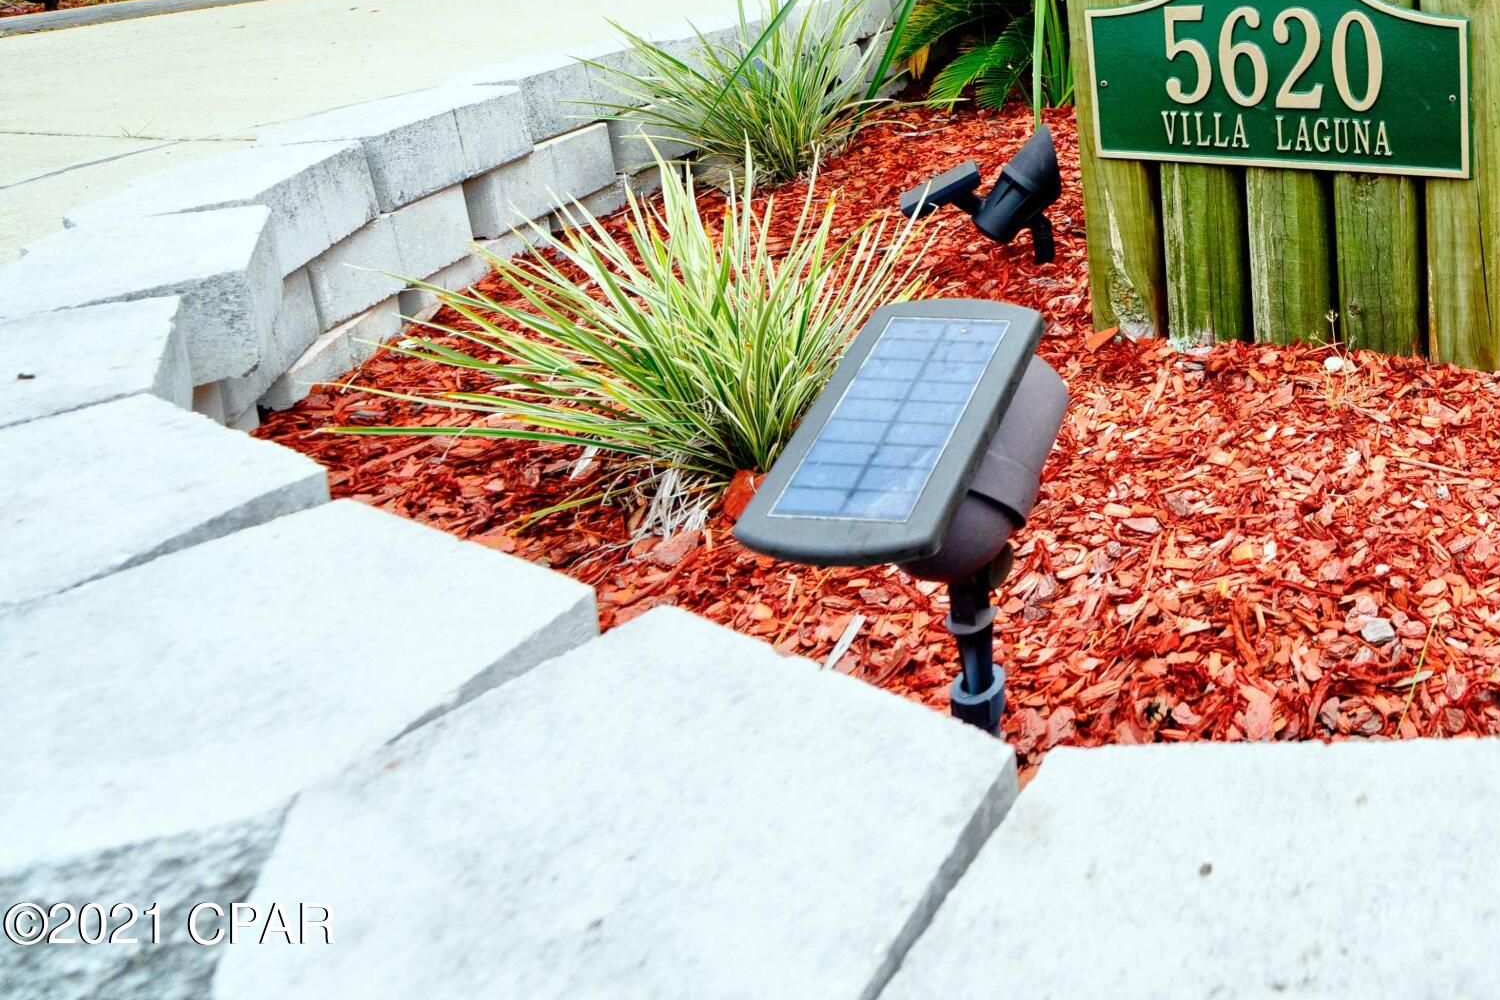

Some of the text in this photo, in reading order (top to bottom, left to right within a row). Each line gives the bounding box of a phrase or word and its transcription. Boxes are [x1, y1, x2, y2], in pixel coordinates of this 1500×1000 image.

[1163, 4, 1384, 112] 5620
[1161, 109, 1393, 157] VILLA LAGUNA
